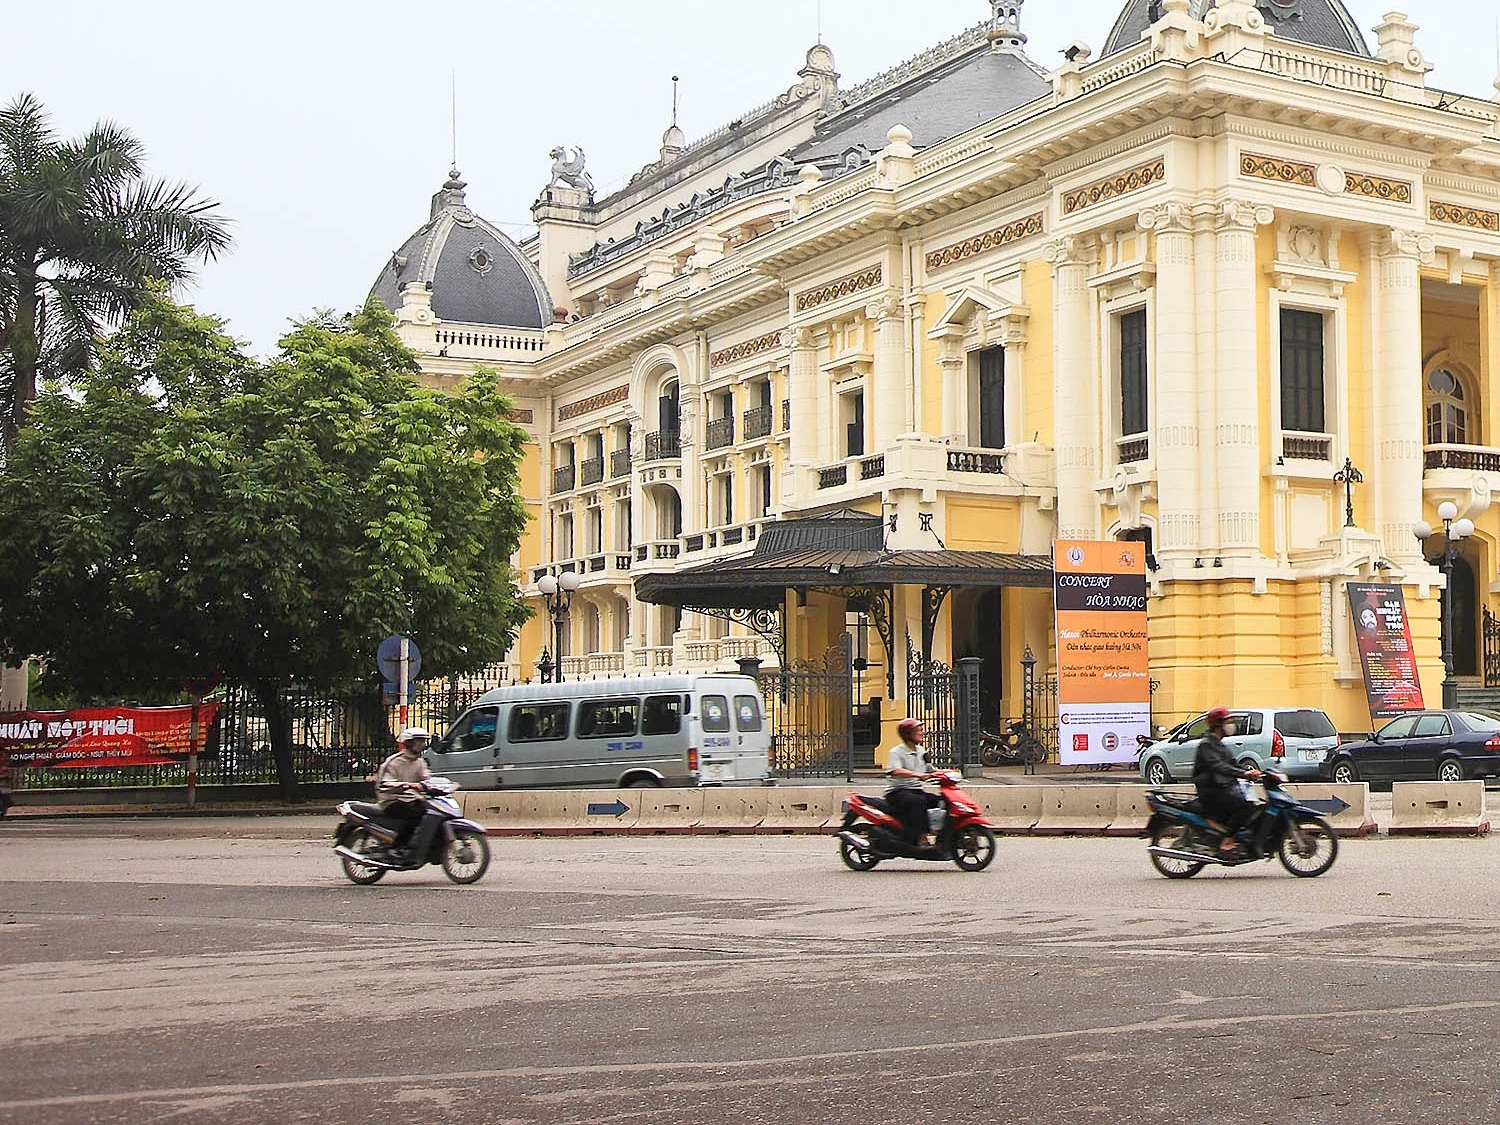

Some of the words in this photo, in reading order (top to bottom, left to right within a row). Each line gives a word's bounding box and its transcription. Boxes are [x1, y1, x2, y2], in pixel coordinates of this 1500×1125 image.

[1059, 575, 1113, 589] CONCERT
[1086, 592, 1110, 608] HÒA
[1112, 595, 1145, 610] NHẠC
[47, 718, 87, 740] MỘT
[89, 716, 134, 735] THỜI
